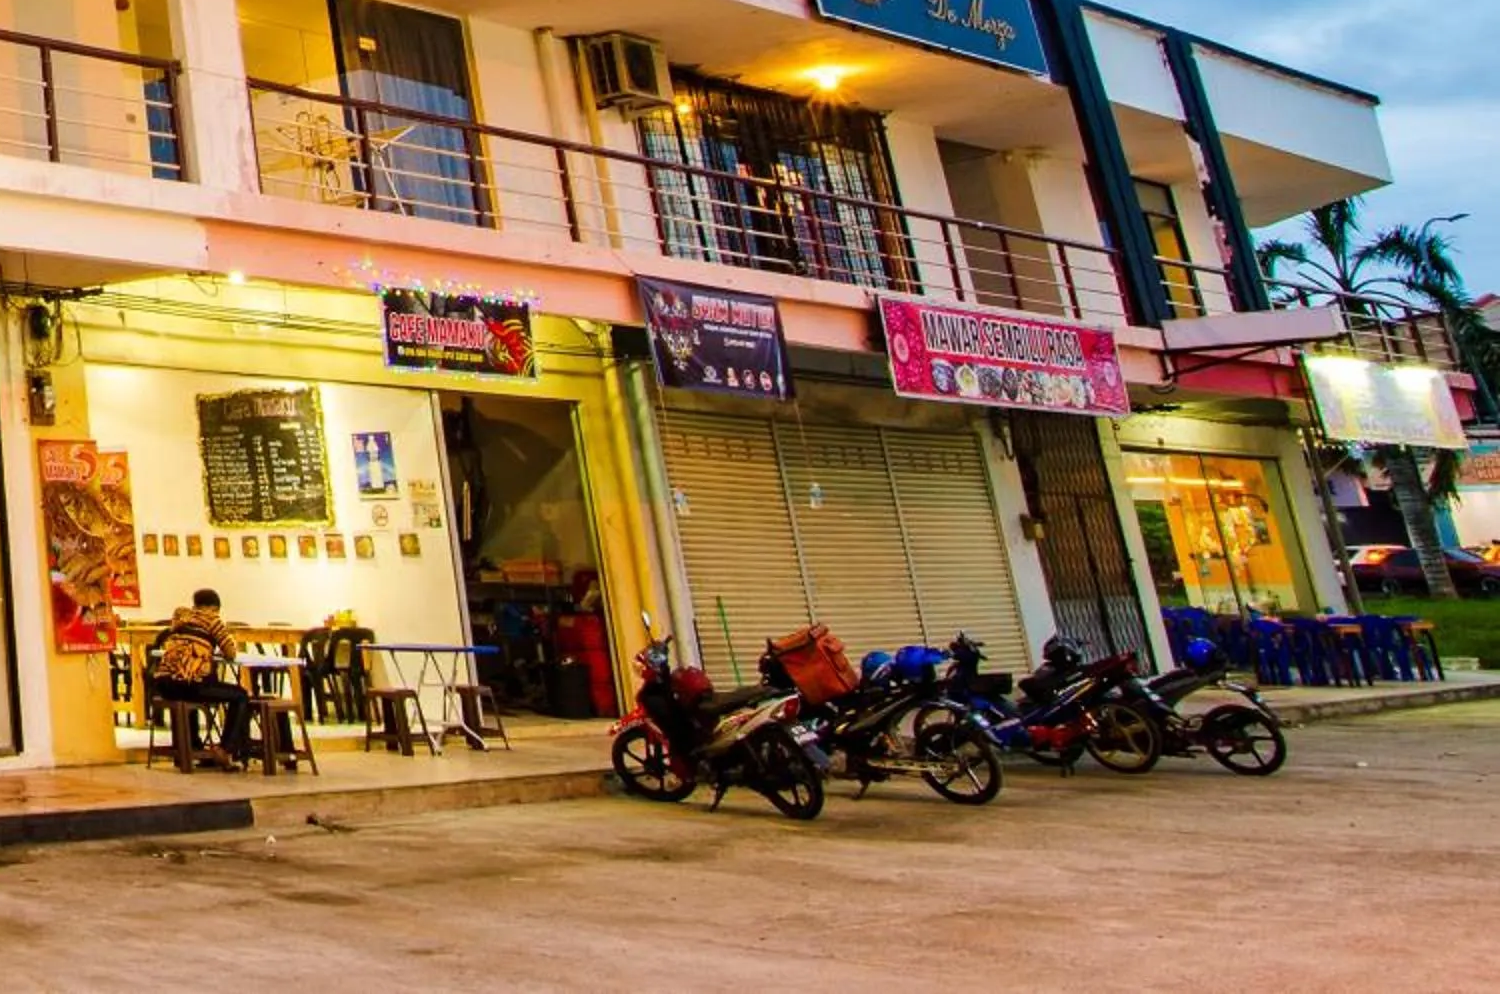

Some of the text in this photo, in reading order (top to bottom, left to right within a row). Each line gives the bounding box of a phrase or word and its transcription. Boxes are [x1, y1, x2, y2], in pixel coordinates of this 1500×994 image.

[389, 312, 424, 343] CAFE
[919, 310, 1086, 371] MAWAR SEMBILU RASA
